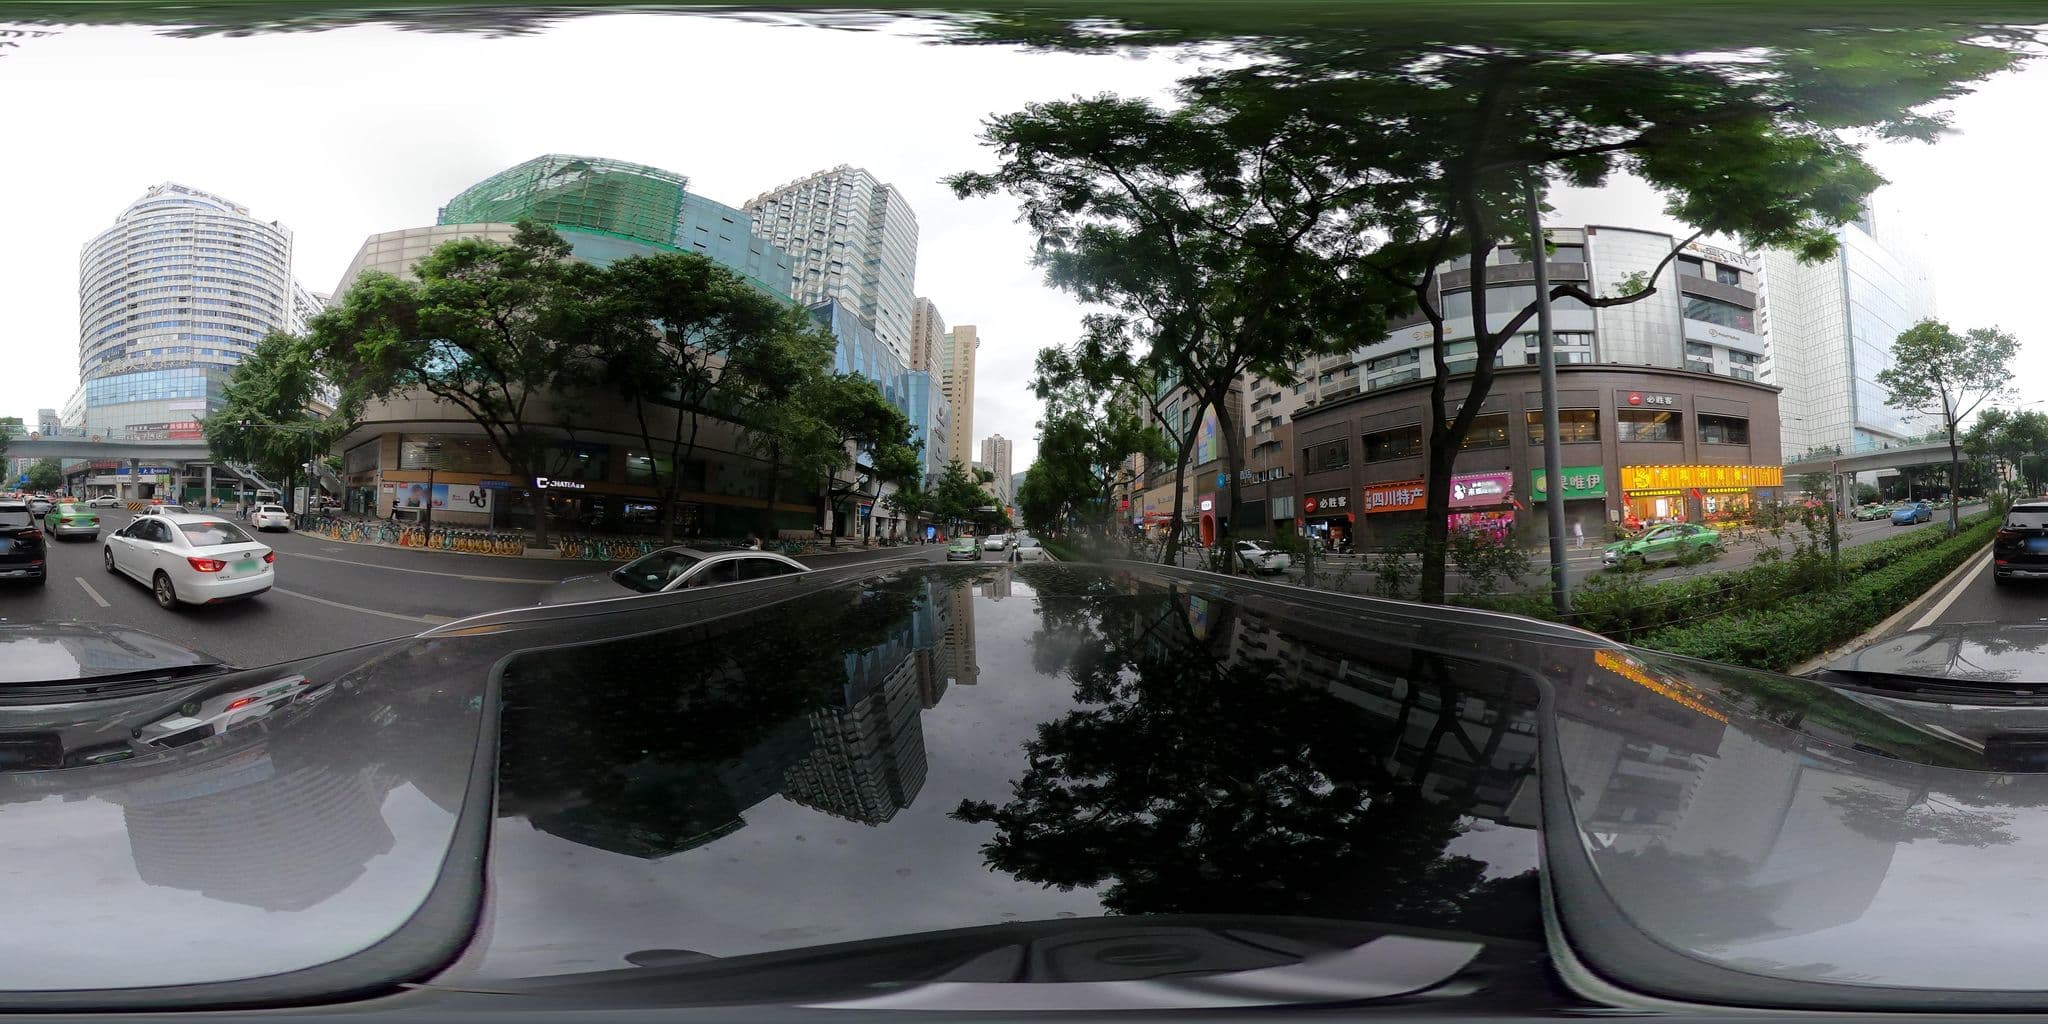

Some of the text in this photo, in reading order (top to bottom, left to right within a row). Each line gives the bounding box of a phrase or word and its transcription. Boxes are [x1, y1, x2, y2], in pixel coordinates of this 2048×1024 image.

[1646, 395, 1673, 405] 必胜客
[1320, 496, 1347, 509] 必胜客
[1372, 488, 1424, 507] 四川特产
